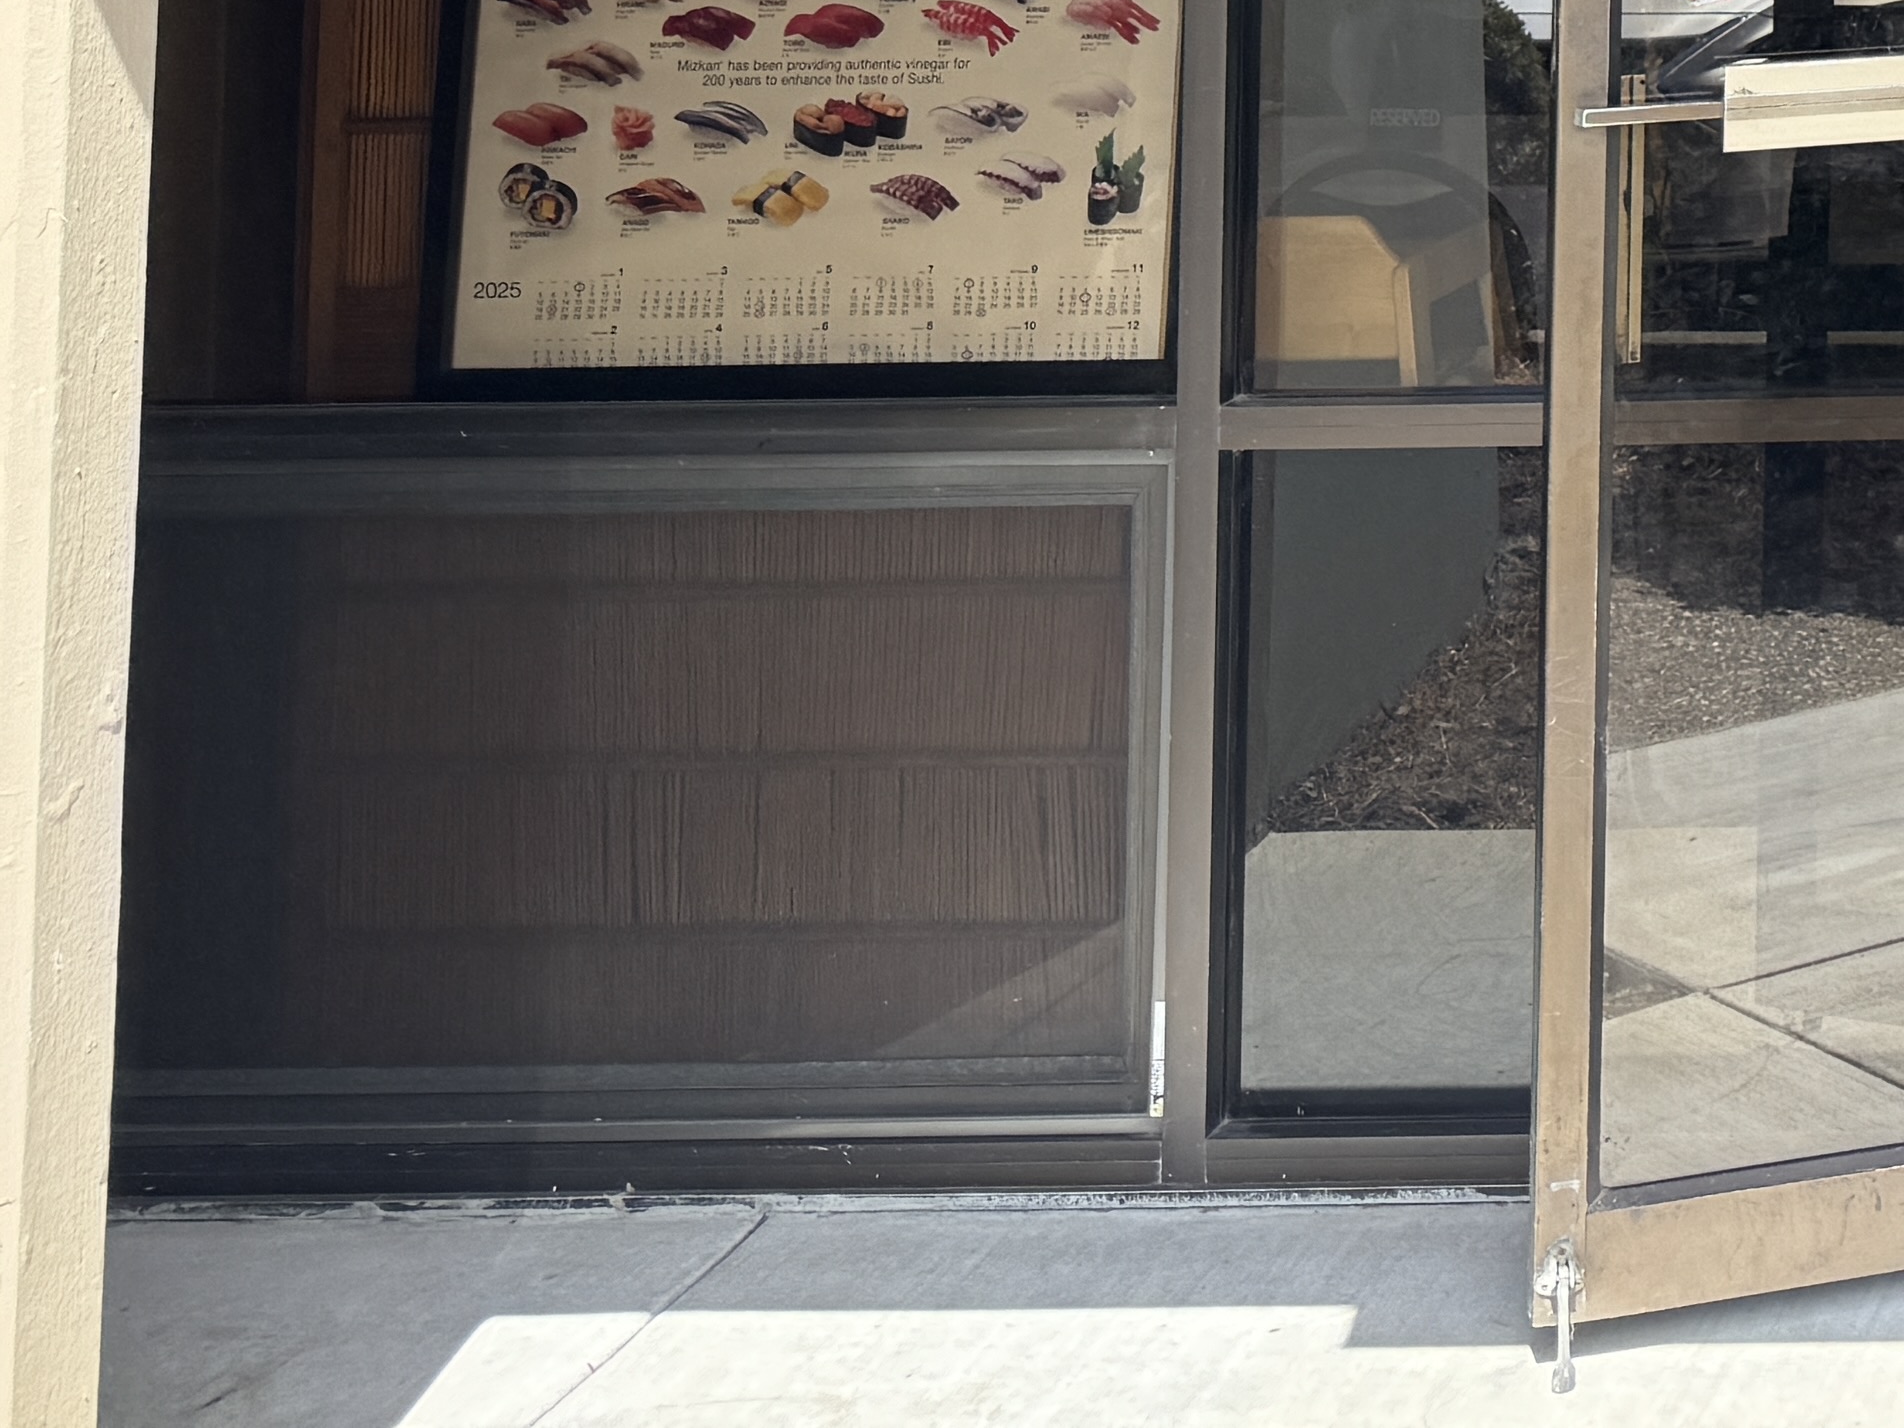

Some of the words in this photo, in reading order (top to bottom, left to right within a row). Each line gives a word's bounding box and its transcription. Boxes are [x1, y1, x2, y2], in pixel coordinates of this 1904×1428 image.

[728, 59, 749, 71] has
[753, 59, 782, 71] been
[786, 58, 841, 75] providing
[846, 57, 901, 71] authentic
[905, 59, 951, 74] vinegar
[953, 57, 971, 70] for
[702, 74, 725, 87] 200
[728, 75, 761, 89] years
[765, 75, 777, 86] to
[781, 73, 830, 86] enhance
[835, 73, 854, 85] the
[857, 73, 888, 85] taste
[891, 73, 905, 84] of
[618, 267, 625, 277] 1
[720, 266, 729, 276] 3
[825, 264, 833, 275] 5
[927, 264, 935, 274] 7
[1031, 264, 1039, 274] 9
[1131, 263, 1145, 273] 11
[473, 281, 522, 300] 2025
[610, 325, 618, 335] 2
[715, 323, 723, 333] 4
[821, 322, 829, 332] 6
[926, 321, 934, 331] 8
[1023, 321, 1037, 331] 10
[1126, 321, 1140, 330] 12
